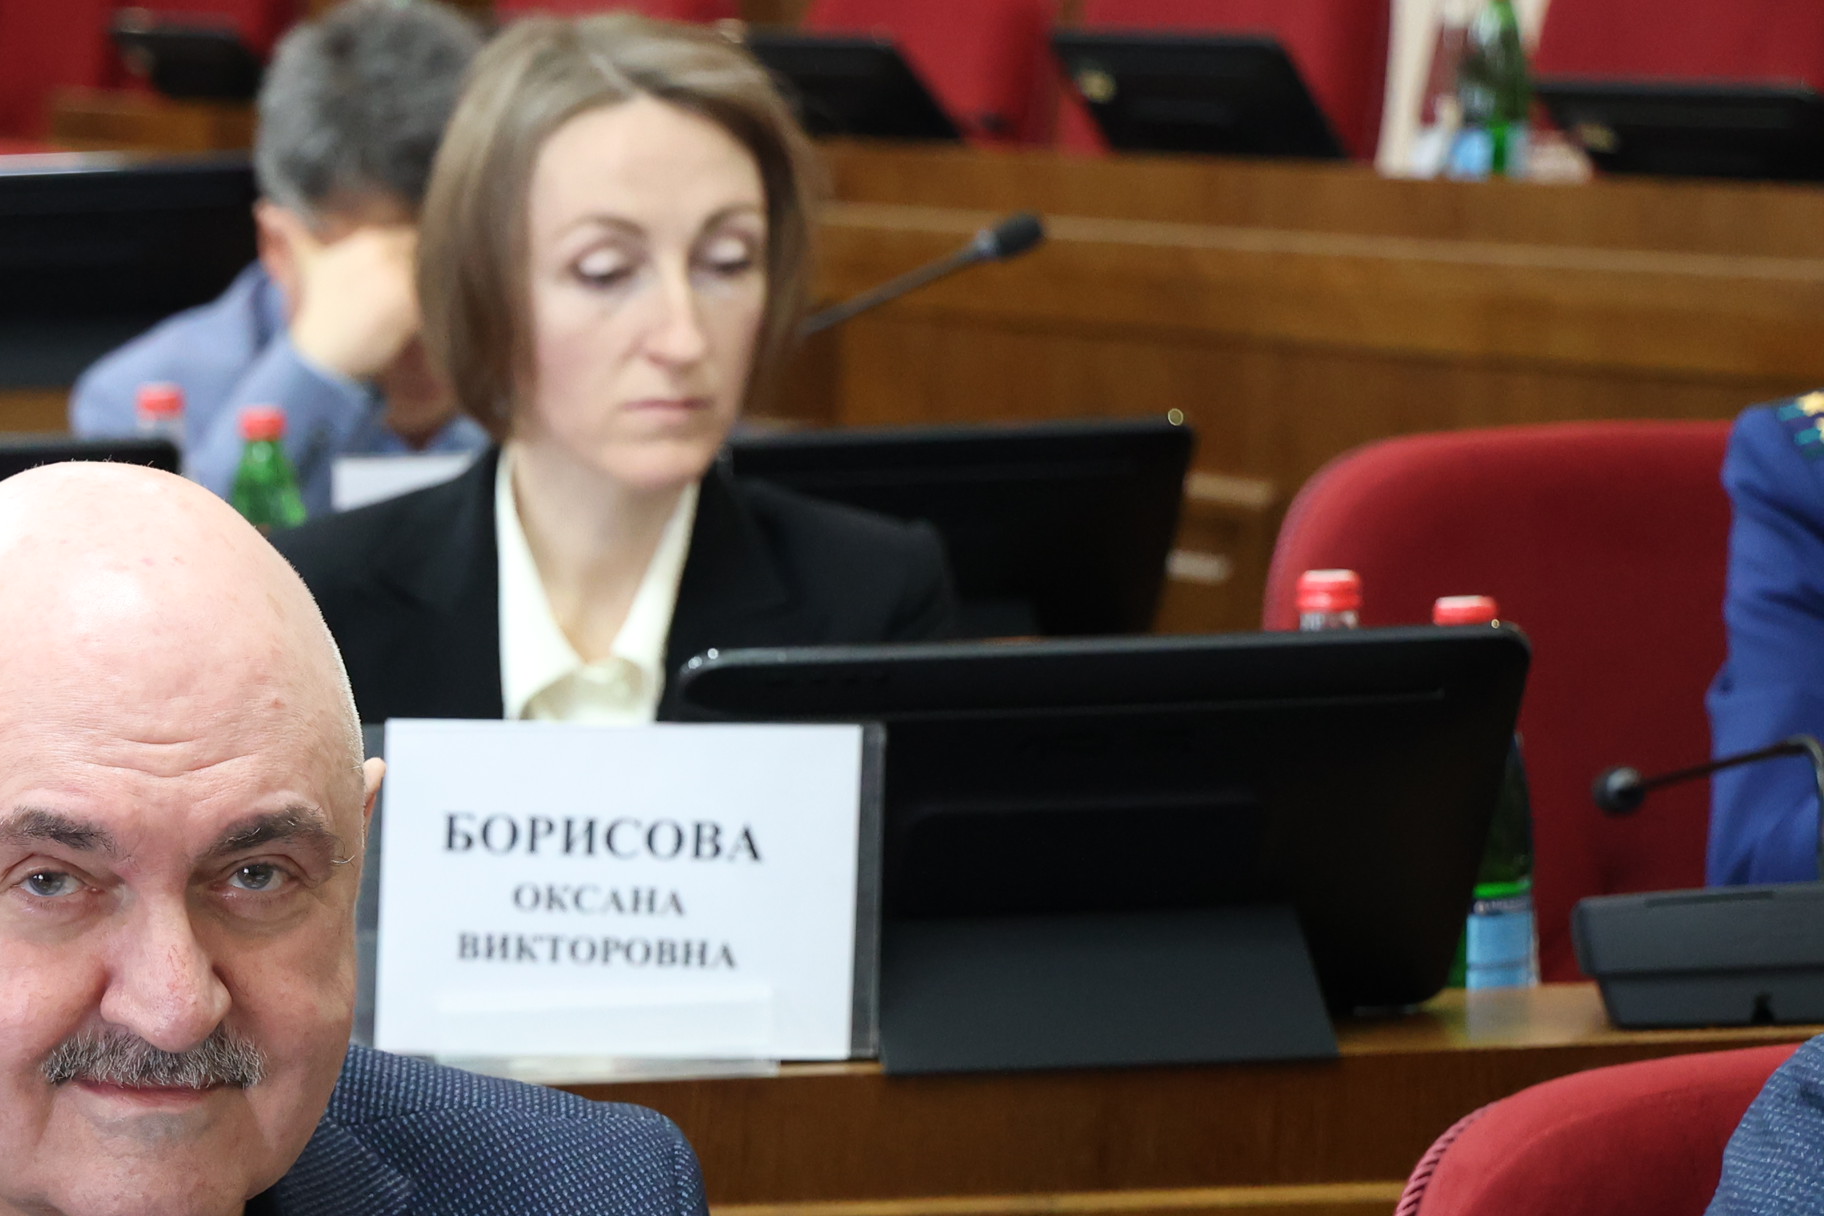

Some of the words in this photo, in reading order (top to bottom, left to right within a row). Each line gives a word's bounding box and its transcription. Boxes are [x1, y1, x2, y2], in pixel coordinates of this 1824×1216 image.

[442, 813, 763, 863] БОРИСОВА
[512, 883, 685, 916] ОКСАНА
[457, 932, 737, 969] ВИКТОРОВНА
